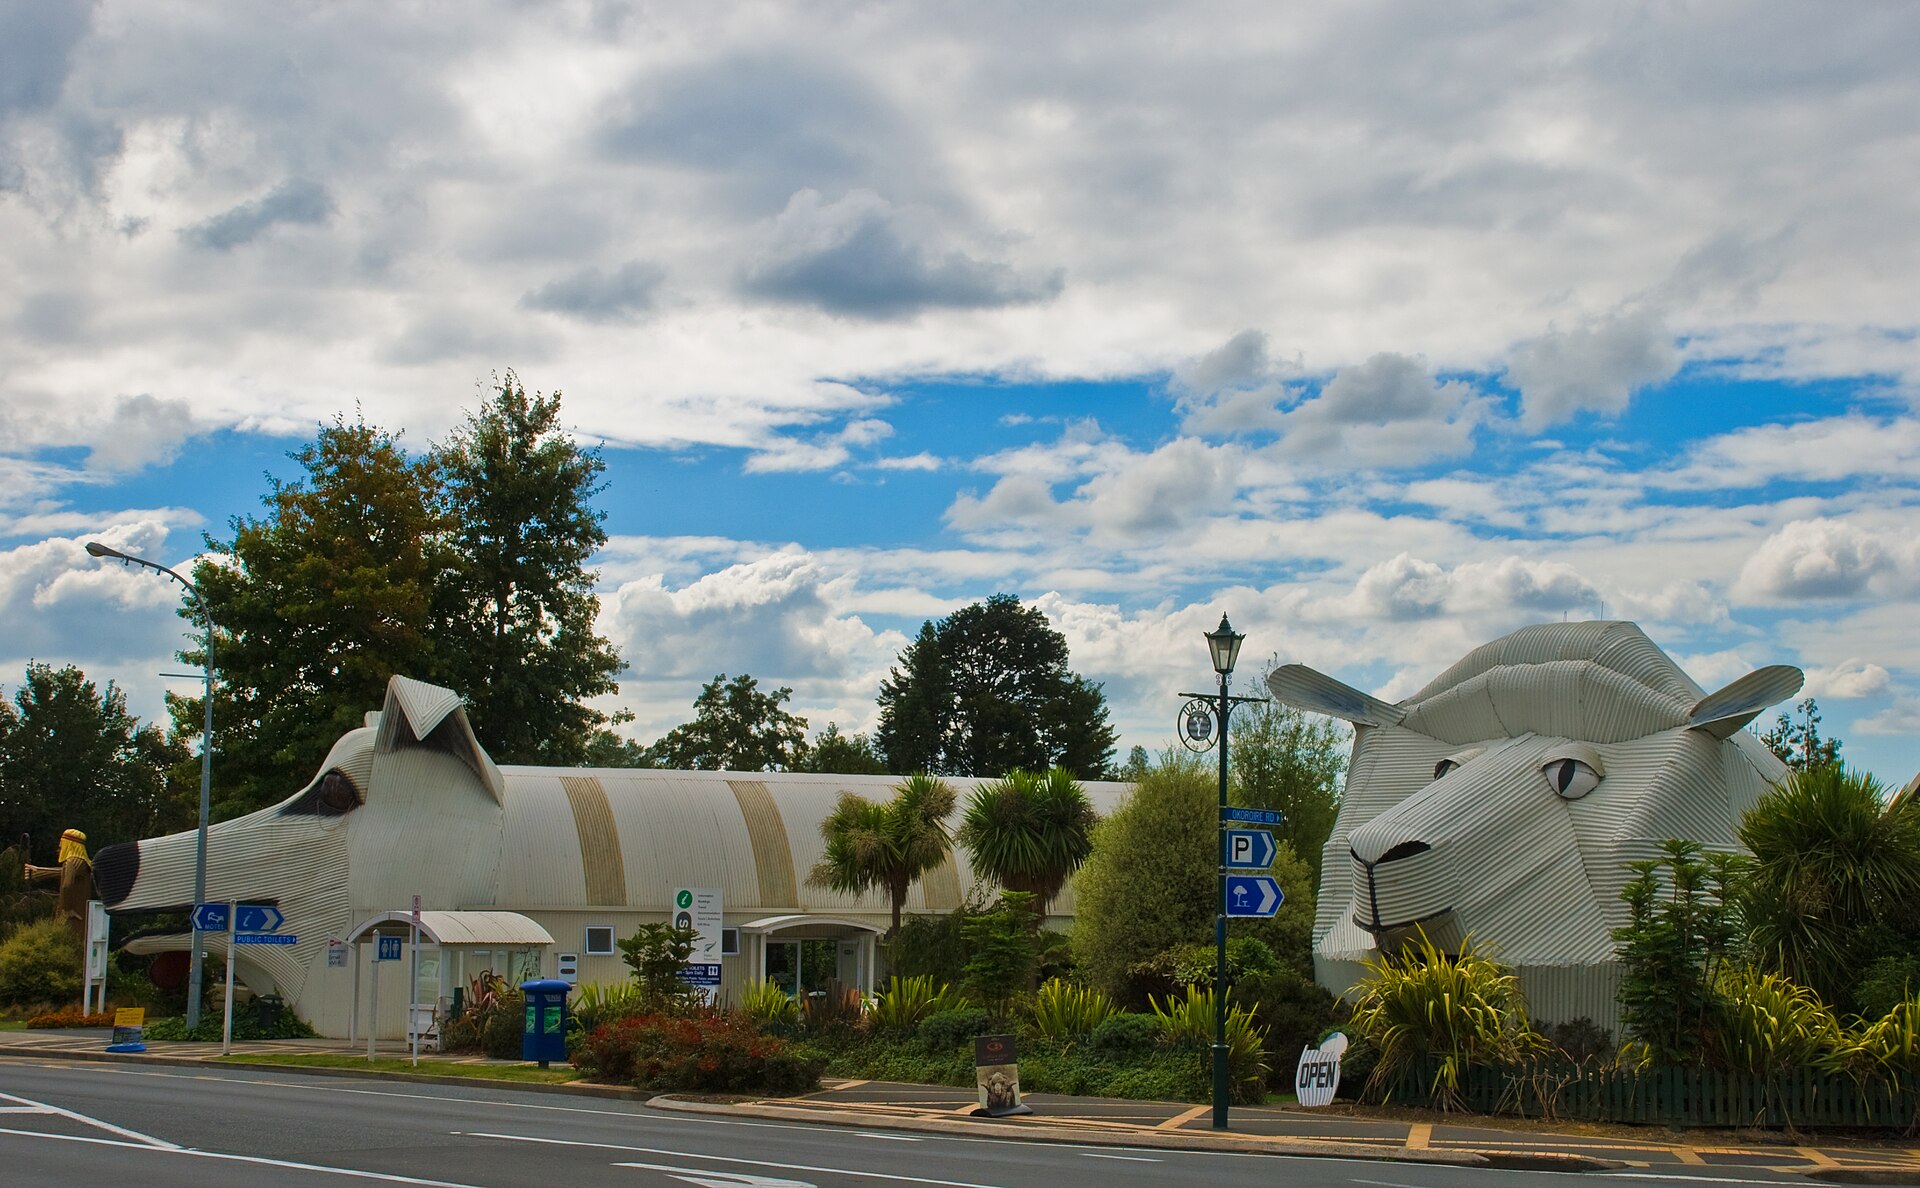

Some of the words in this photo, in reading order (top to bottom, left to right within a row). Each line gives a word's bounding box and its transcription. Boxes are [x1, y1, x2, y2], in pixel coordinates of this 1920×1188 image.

[1232, 809, 1263, 820] OKOROIRE
[1265, 812, 1275, 822] RD
[1235, 837, 1249, 860] P
[1300, 1061, 1336, 1088] OPEN
